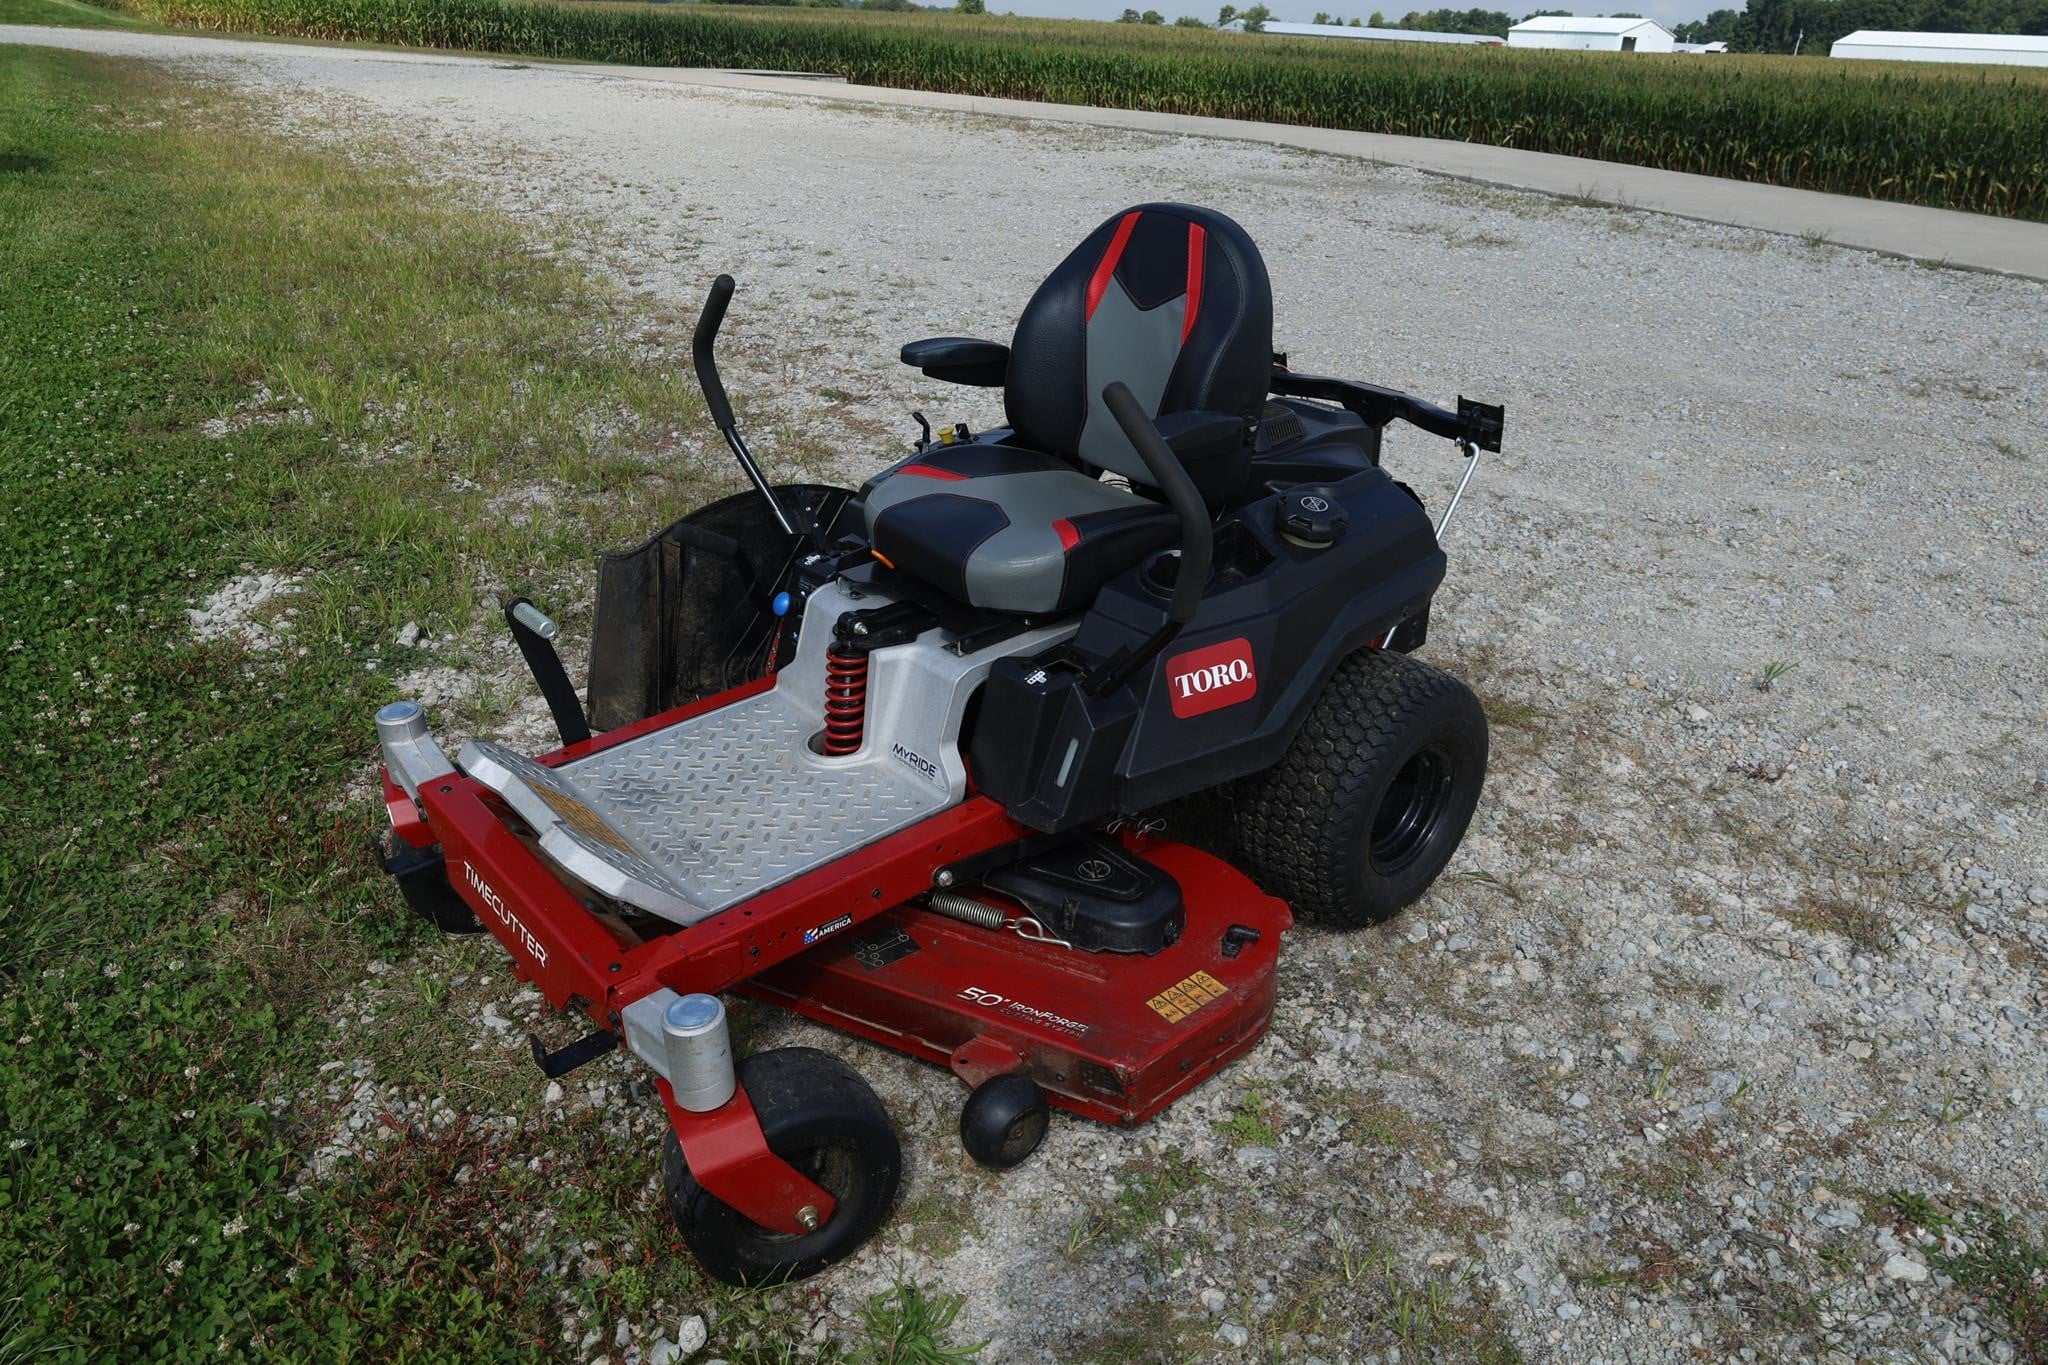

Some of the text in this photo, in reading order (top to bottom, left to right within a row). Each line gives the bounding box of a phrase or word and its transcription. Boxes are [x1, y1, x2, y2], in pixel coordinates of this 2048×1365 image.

[1174, 658, 1249, 698] TORO
[463, 860, 546, 968] TIMECUTTER
[818, 917, 852, 938] AMERICA
